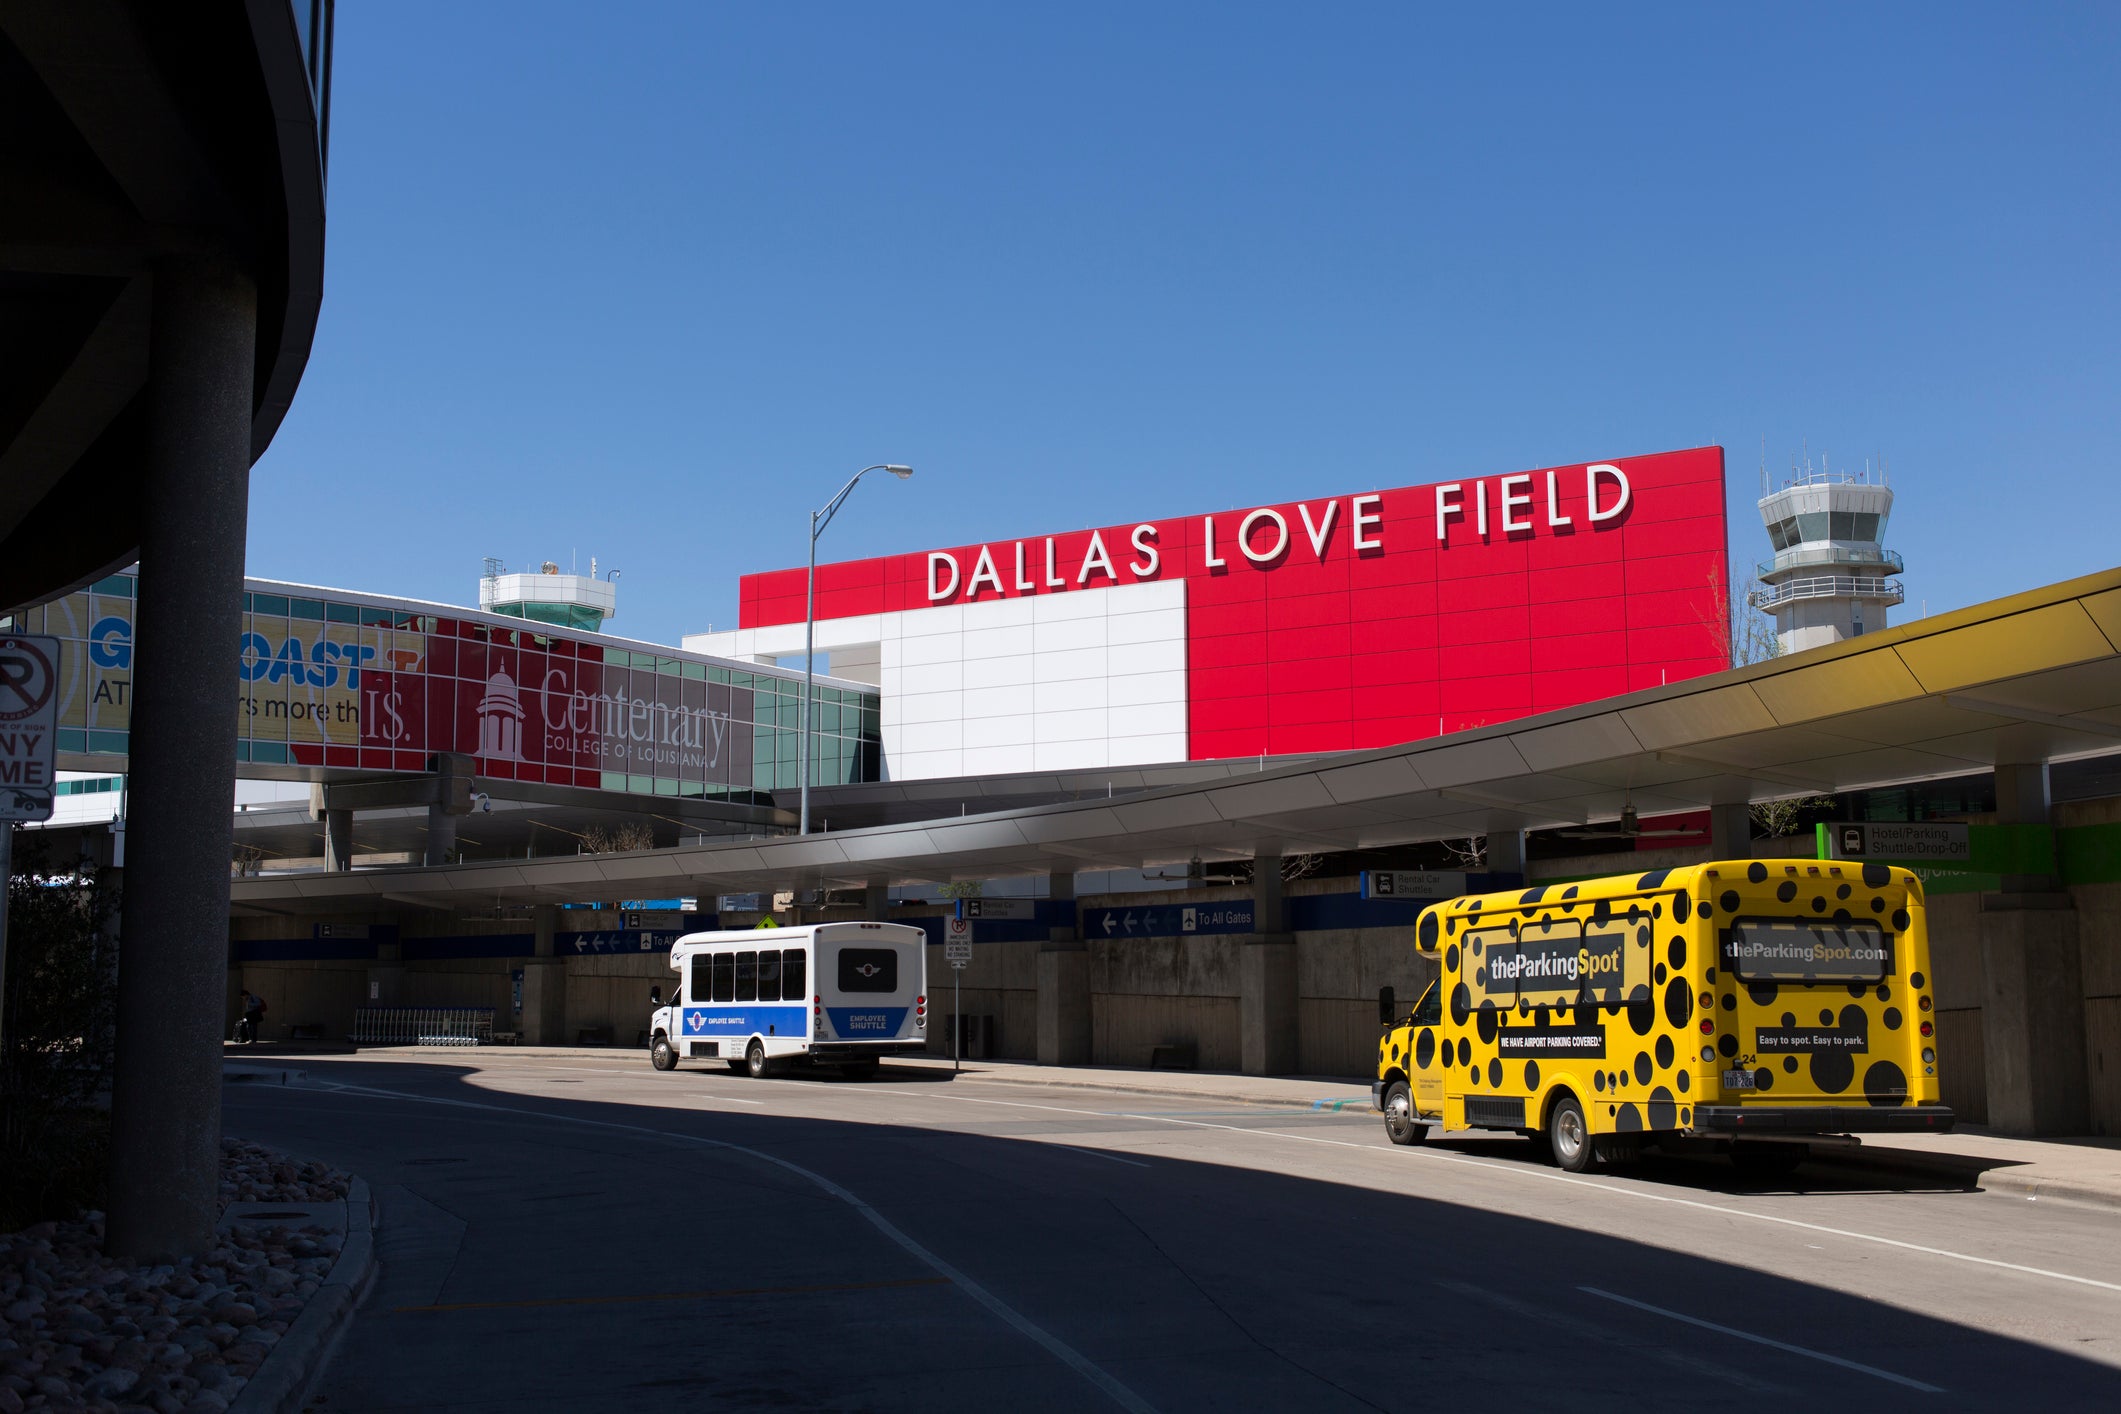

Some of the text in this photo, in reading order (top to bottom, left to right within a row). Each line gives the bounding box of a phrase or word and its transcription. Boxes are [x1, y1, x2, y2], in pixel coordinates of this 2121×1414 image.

[928, 463, 1631, 602] DALLAS LOVE FIELD
[240, 631, 376, 691] OAST
[265, 699, 331, 723] more
[540, 668, 729, 769] Centenary
[10, 723, 22, 731] OF
[25, 724, 46, 732] SIGN
[0, 732, 41, 758] NY
[544, 733, 709, 769] COLLEGE OF LOUISIANA
[1872, 827, 1949, 842] Hotel/Parking
[1872, 842, 1968, 855] Shuttle/Drop-Off
[1398, 874, 1440, 884] Rental Car
[1398, 886, 1433, 894] Shuttles
[1198, 910, 1252, 926] To All Gates
[653, 936, 663, 947] To
[664, 935, 674, 946] All
[1724, 941, 1888, 962] theParkingSpot.com
[708, 1017, 745, 1025] EMPLOYEE SHUTTLE
[850, 1022, 887, 1030] SHUTTLE
[1500, 1037, 1509, 1048] WE
[1509, 1037, 1524, 1048] HAVE
[1524, 1037, 1547, 1048] AIRPORT
[1547, 1036, 1571, 1047] PARKING
[1759, 1035, 1865, 1047] Easy to spot. Easy to park.
[1742, 1054, 1756, 1064] 24
